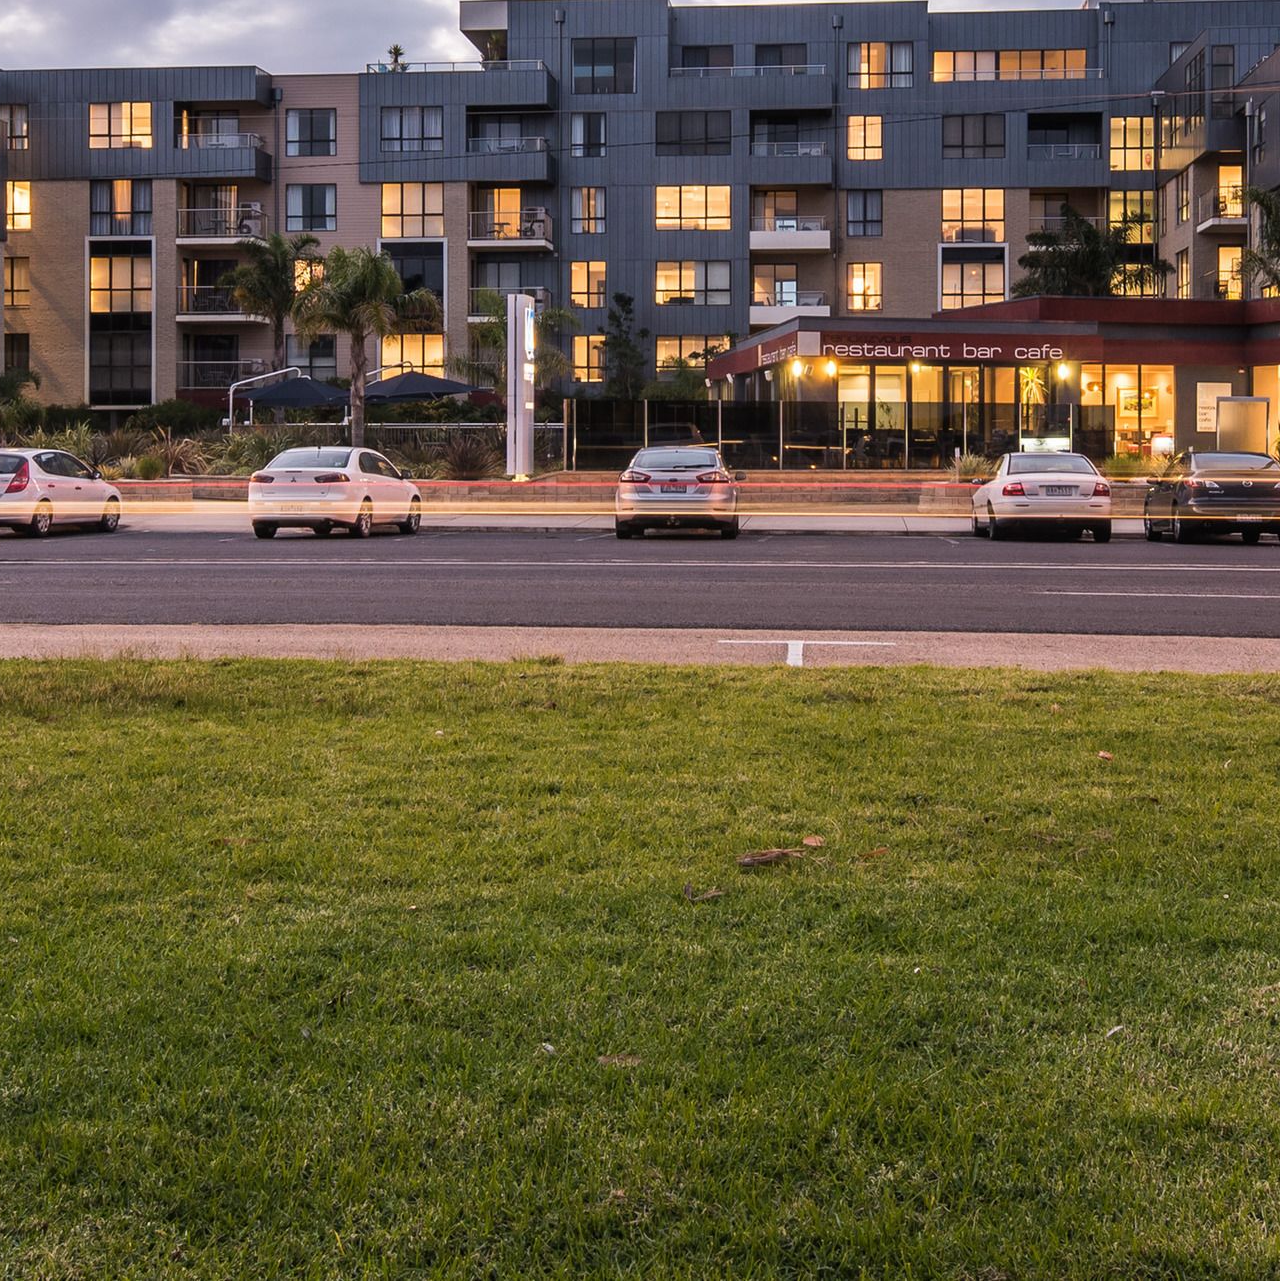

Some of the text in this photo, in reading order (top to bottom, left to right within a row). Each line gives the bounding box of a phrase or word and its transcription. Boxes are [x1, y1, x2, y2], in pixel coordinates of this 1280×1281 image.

[823, 343, 1063, 359] restaurant bar cafe
